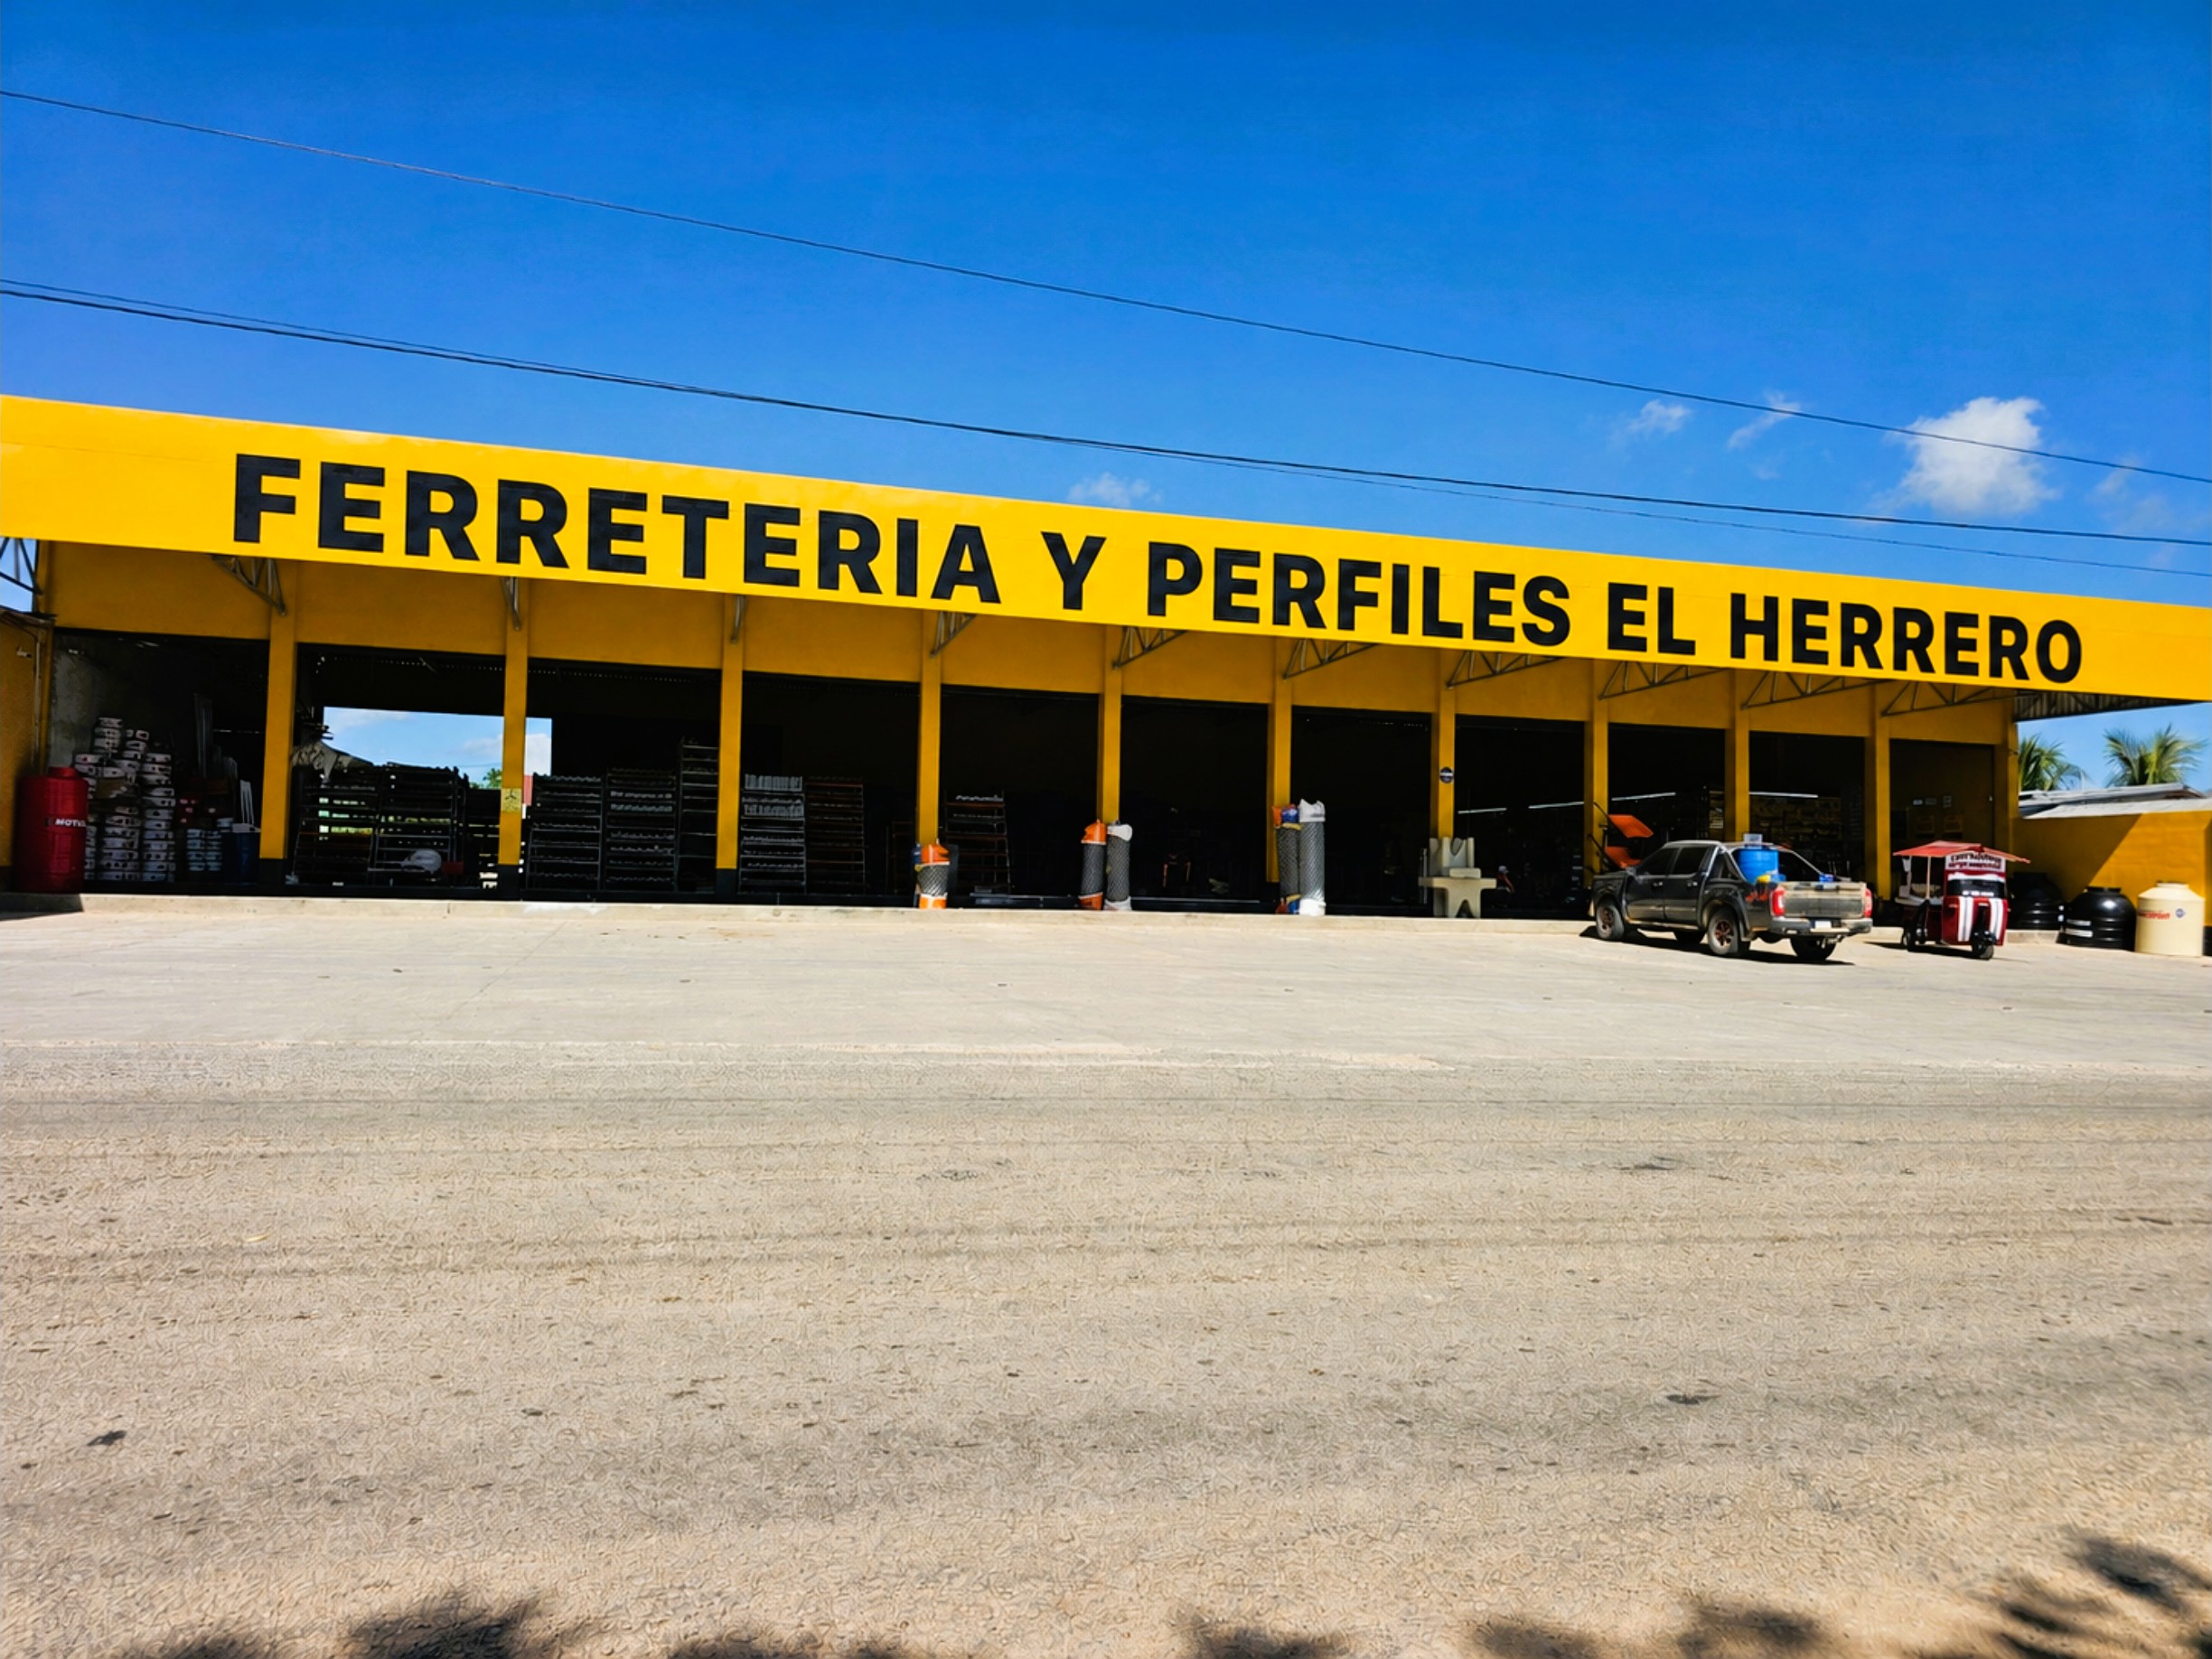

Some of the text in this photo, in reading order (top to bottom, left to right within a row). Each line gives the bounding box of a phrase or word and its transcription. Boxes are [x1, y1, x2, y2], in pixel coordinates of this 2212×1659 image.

[234, 454, 2082, 684] FERRETERIA Y PERFILES EL HERRERO
